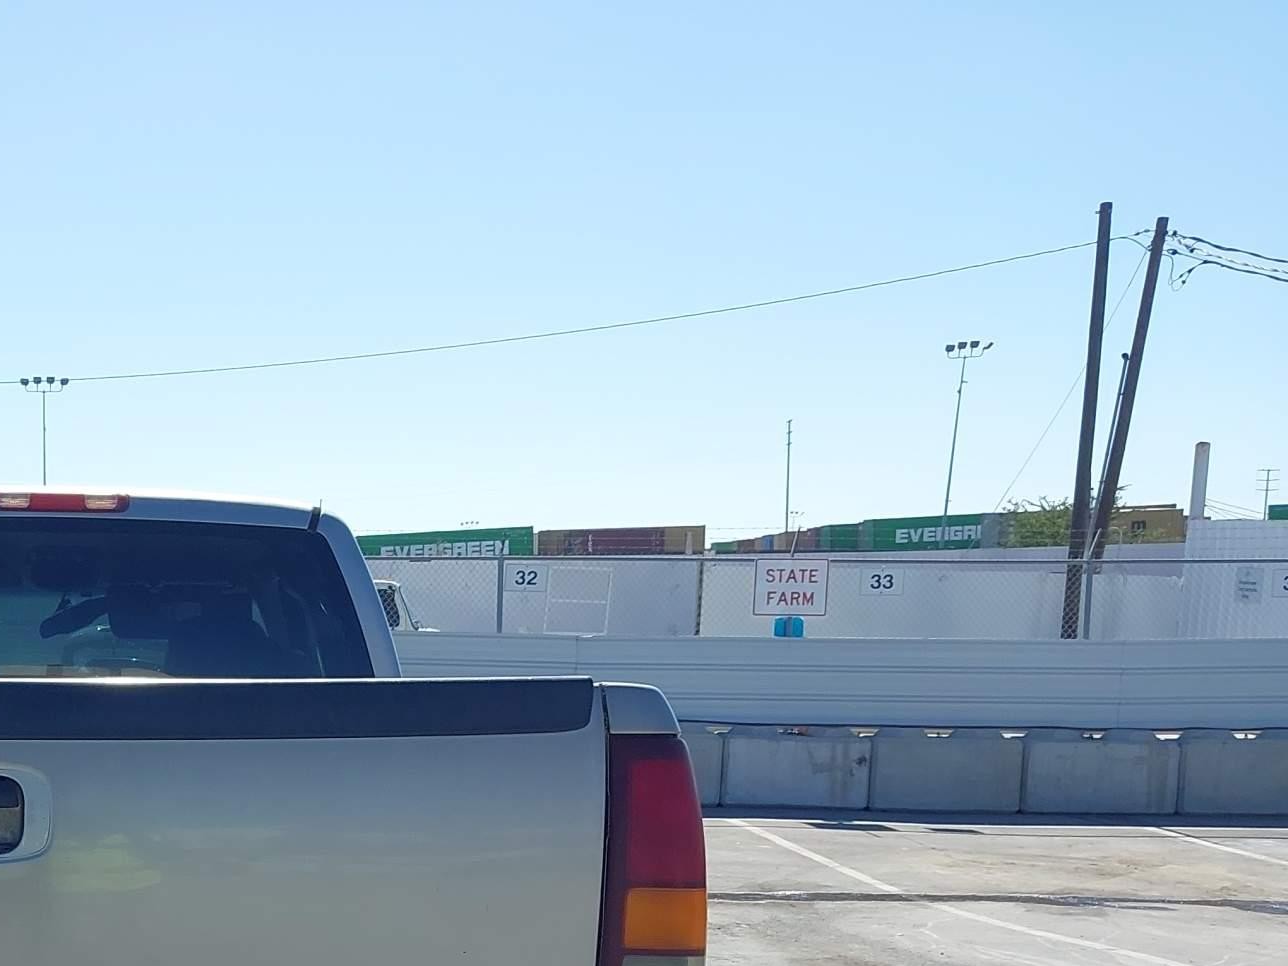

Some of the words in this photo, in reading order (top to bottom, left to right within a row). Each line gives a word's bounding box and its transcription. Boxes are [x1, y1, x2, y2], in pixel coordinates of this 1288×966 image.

[514, 570, 538, 586] 32
[765, 568, 819, 584] STATE
[869, 574, 894, 590] 33
[766, 591, 815, 606] FARM
